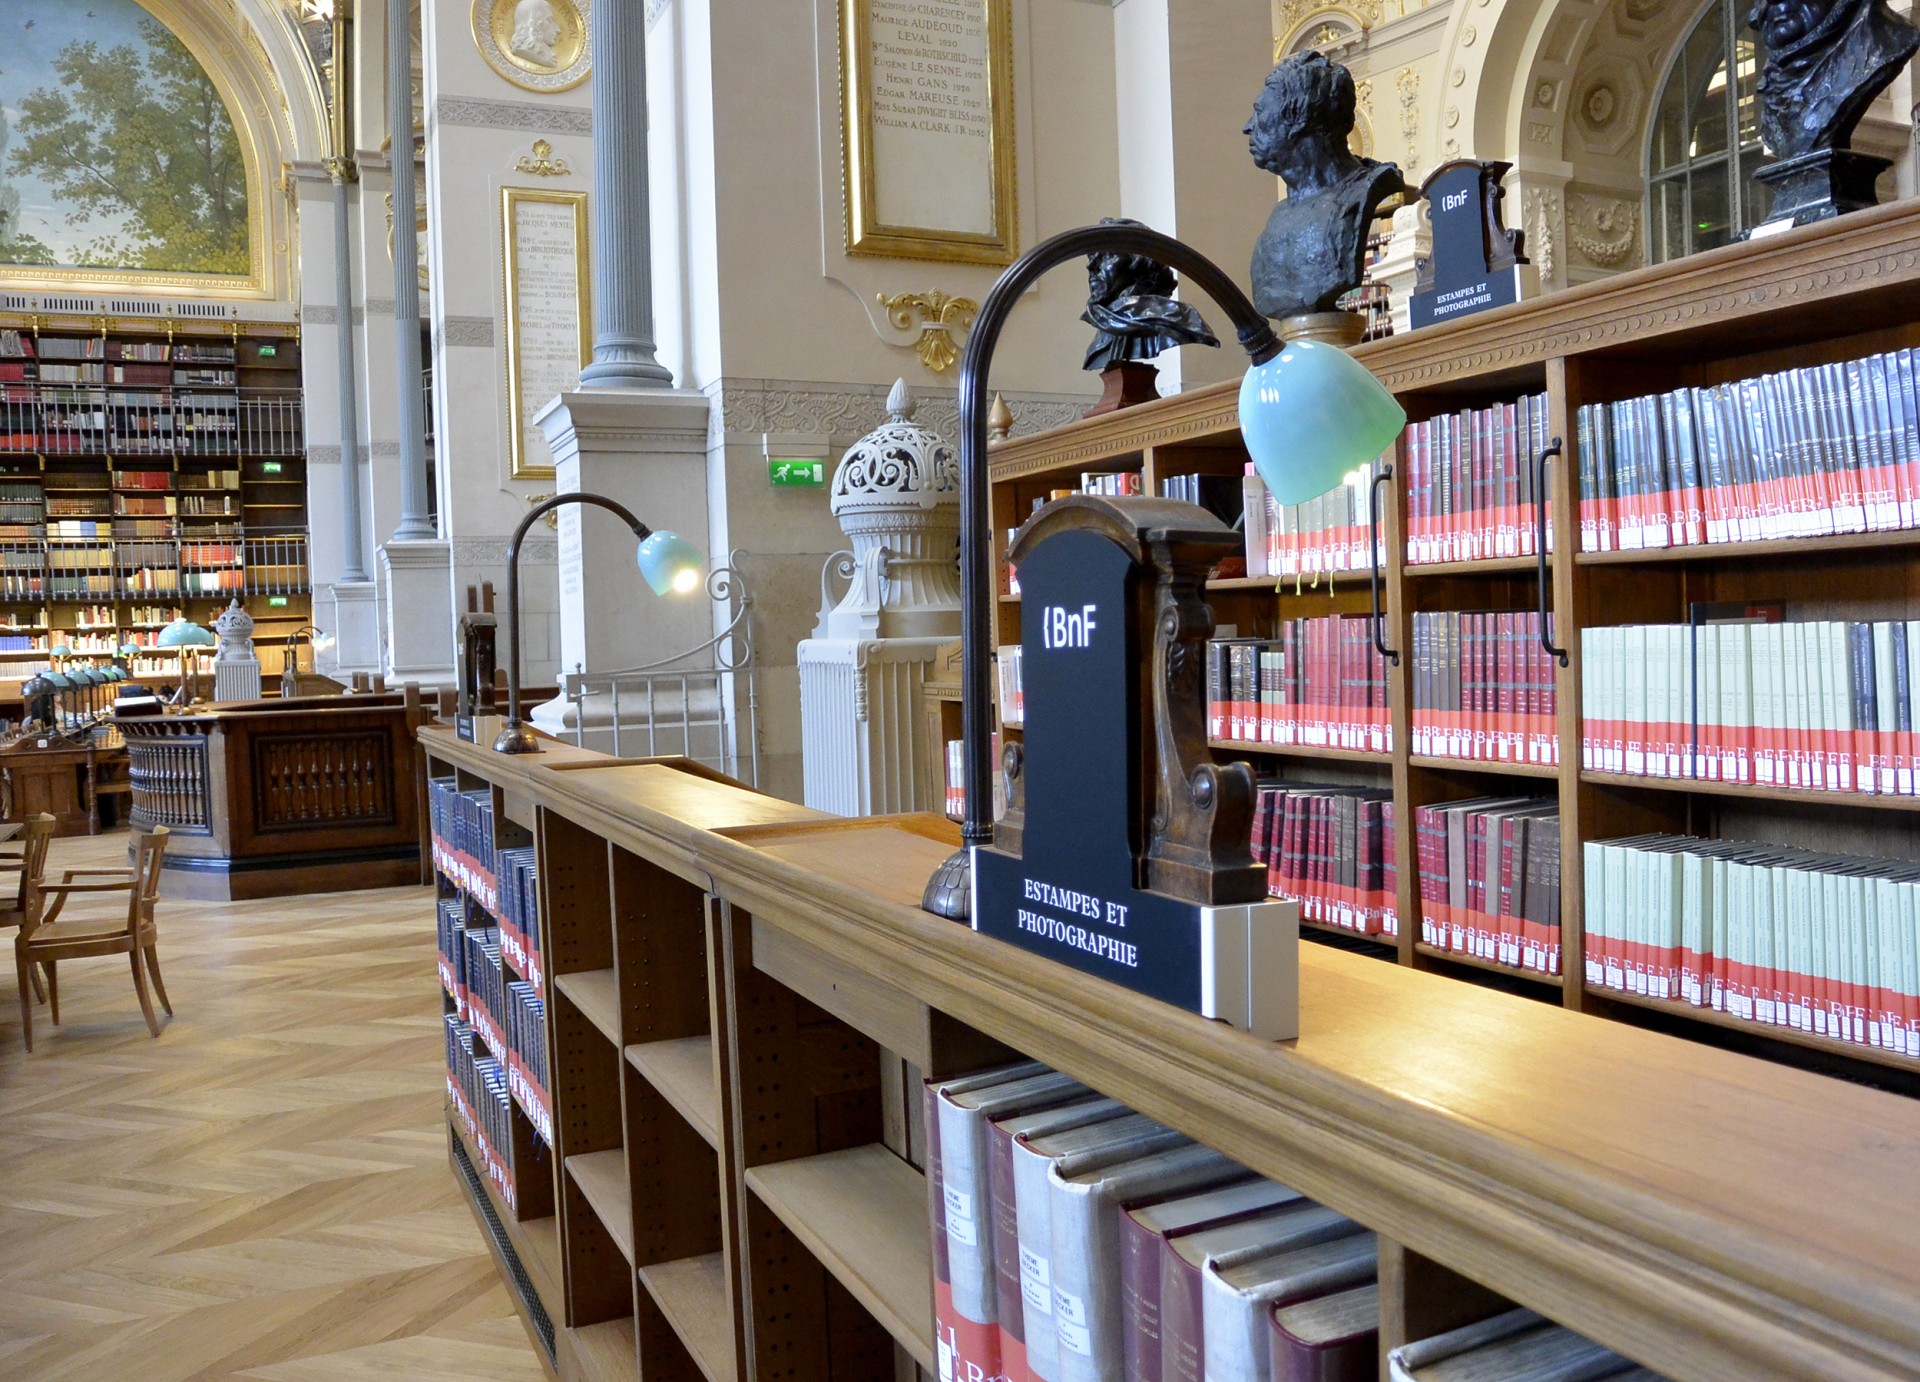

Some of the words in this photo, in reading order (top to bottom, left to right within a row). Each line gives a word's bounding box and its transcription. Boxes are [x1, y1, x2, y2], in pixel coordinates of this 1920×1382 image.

[872, 12, 908, 26] MAURICE
[917, 5, 966, 20] CHARENCEY
[898, 31, 932, 44] LEVAL
[884, 43, 913, 56] SALOMON
[922, 49, 968, 64] ROTHSCHILD
[911, 62, 924, 72] LE
[927, 64, 962, 77] SENNE
[886, 73, 913, 85] HENRI
[917, 77, 948, 90] GANS
[876, 86, 905, 99] EDGAR
[909, 90, 960, 105] MAREUSE
[892, 103, 916, 115] SUSAN
[917, 106, 947, 119] DWIGHT
[949, 109, 971, 121] BLISS
[874, 116, 908, 129] WILLIAM
[911, 121, 918, 130] A
[919, 121, 951, 133] CLARK
[1437, 286, 1474, 304] ESTAMPES
[1476, 283, 1487, 292] ET
[1434, 293, 1491, 316] PHOTOGRAPHIE
[1024, 878, 1100, 919] ESTAMPES
[1106, 901, 1128, 927] ET
[1018, 908, 1138, 968] PHOTOGRAPHIE
